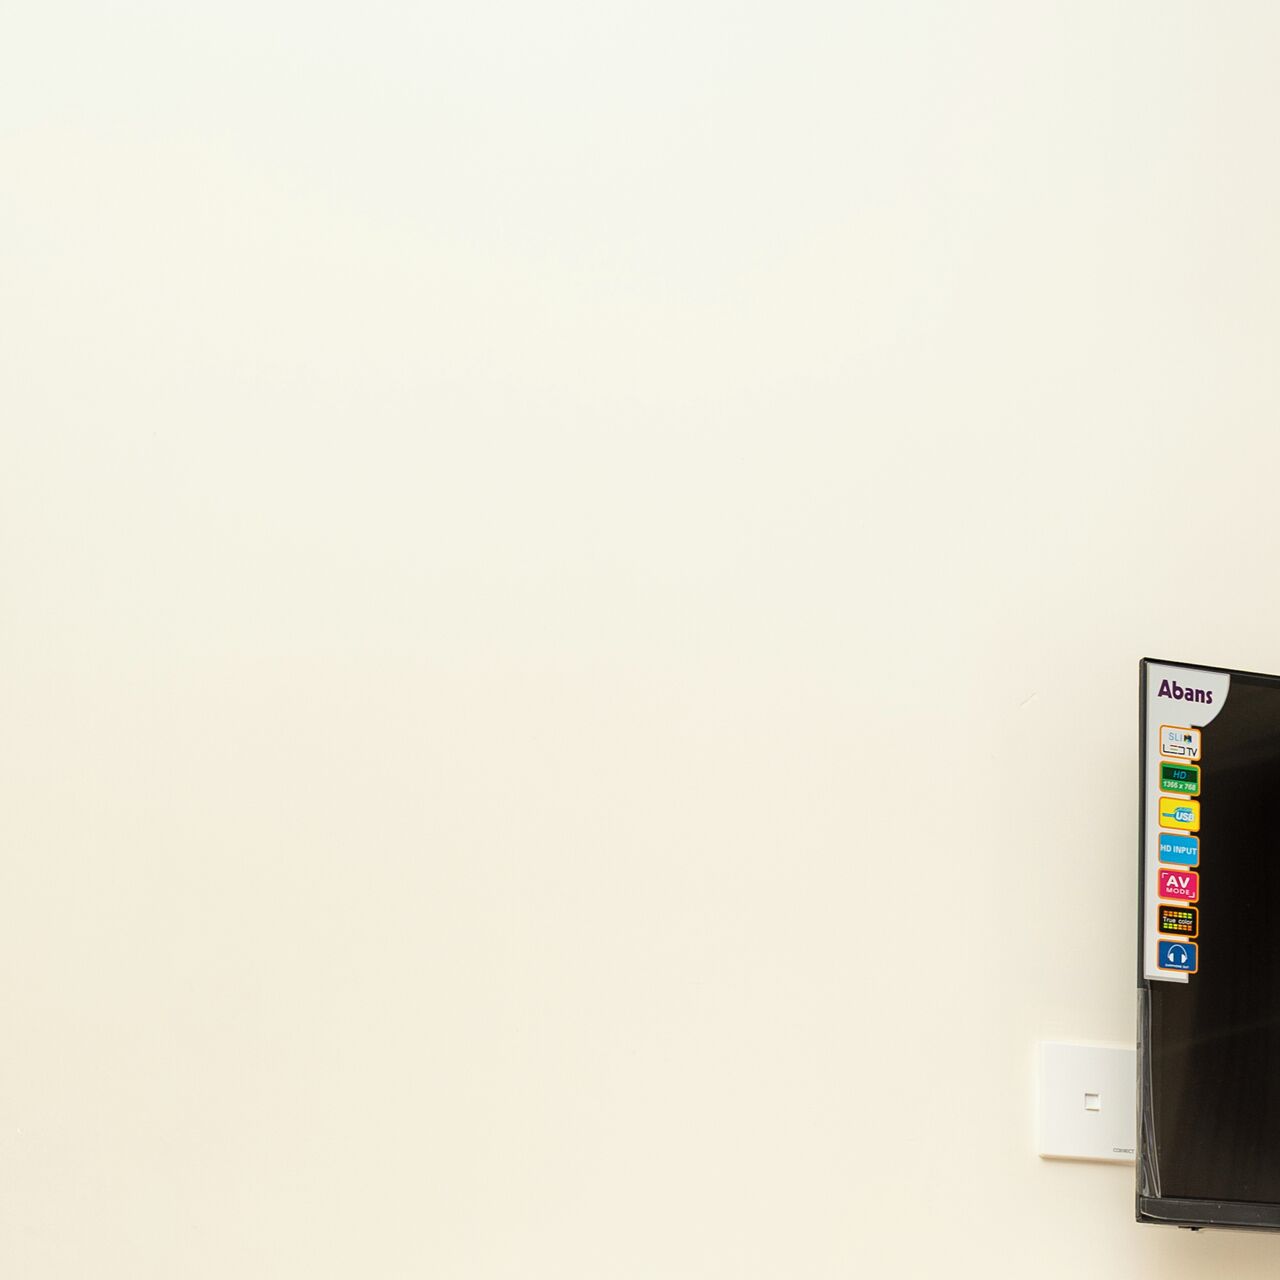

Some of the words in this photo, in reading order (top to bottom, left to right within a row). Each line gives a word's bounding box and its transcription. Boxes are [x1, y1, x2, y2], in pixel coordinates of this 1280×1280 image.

[1158, 679, 1213, 704] Abans
[1169, 732, 1192, 744] SLIM
[1173, 770, 1187, 779] HD
[1176, 811, 1194, 821] USB
[1160, 844, 1172, 852] HD
[1173, 845, 1197, 855] INPUT
[1166, 875, 1190, 889] AV
[1165, 887, 1190, 896] MODE
